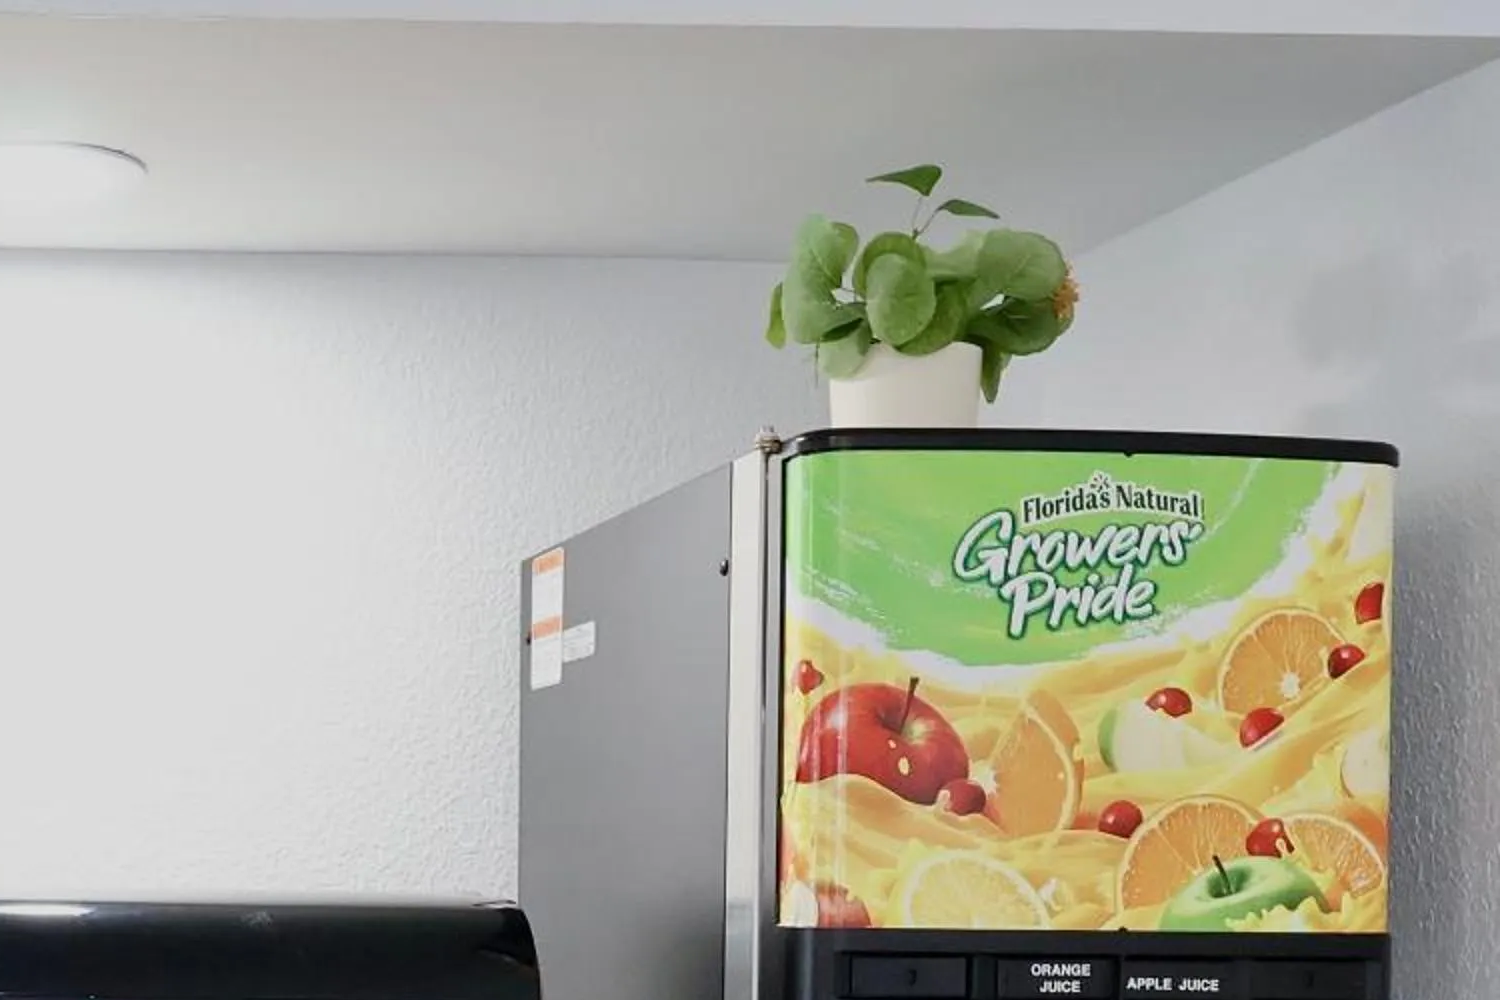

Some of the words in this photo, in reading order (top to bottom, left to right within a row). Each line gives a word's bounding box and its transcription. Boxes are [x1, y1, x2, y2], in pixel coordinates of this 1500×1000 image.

[1115, 484, 1200, 520] Natural
[998, 561, 1160, 640] Pride
[1030, 963, 1091, 977] ORANGE
[1039, 980, 1081, 993] JUICE
[1126, 977, 1172, 991] APPLE
[1178, 978, 1220, 991] JUICE
